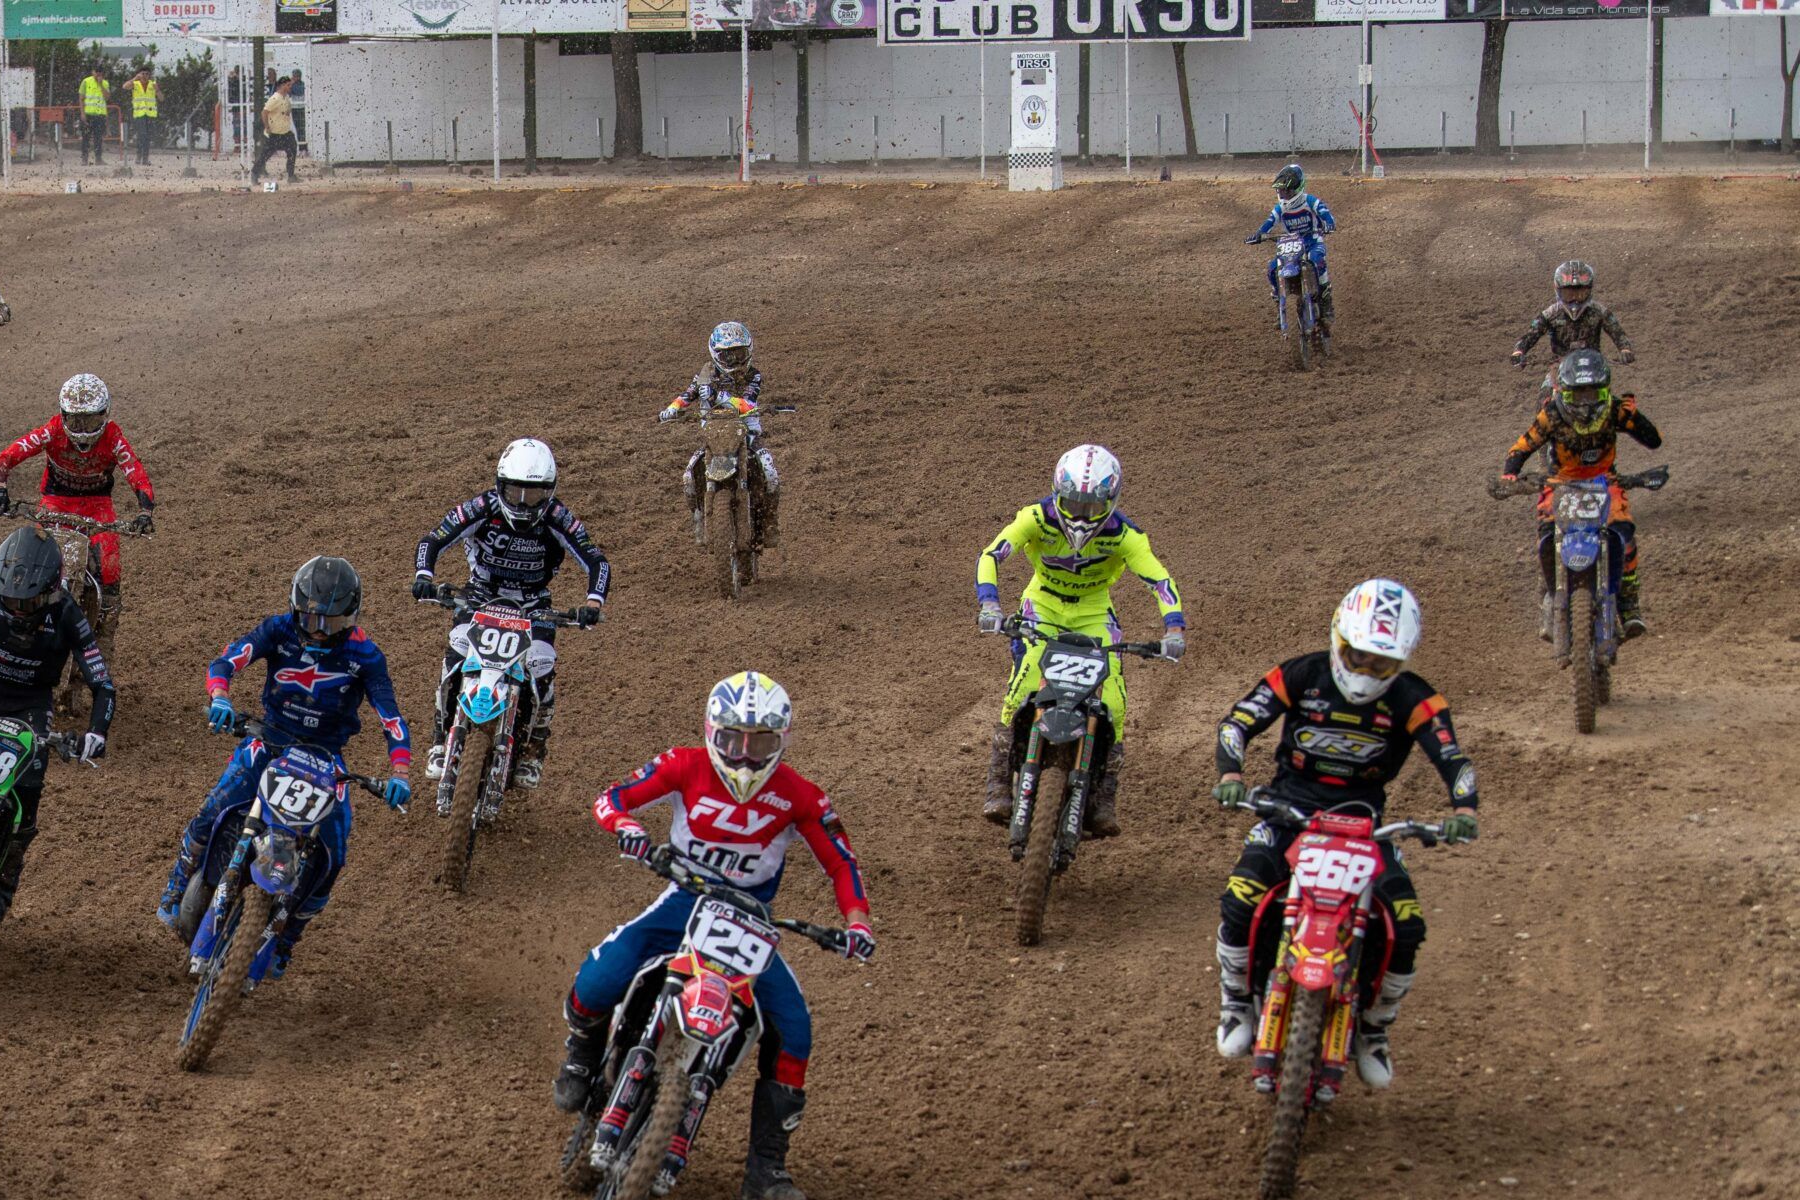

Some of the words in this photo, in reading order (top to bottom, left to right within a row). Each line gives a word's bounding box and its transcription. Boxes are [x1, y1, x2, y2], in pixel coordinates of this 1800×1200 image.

[154, 4, 216, 17] BORJAUTO
[894, 5, 1039, 37] CLUB
[1511, 6, 1530, 15] La
[1533, 5, 1564, 15] Vida
[1568, 7, 1594, 15] son
[1598, 5, 1670, 14] Momenos
[1018, 59, 1049, 69] URSO
[477, 628, 521, 658] 90
[1044, 653, 1104, 685] 223
[689, 796, 776, 836] FLY
[1295, 848, 1377, 895] 268
[691, 911, 773, 976] 129
